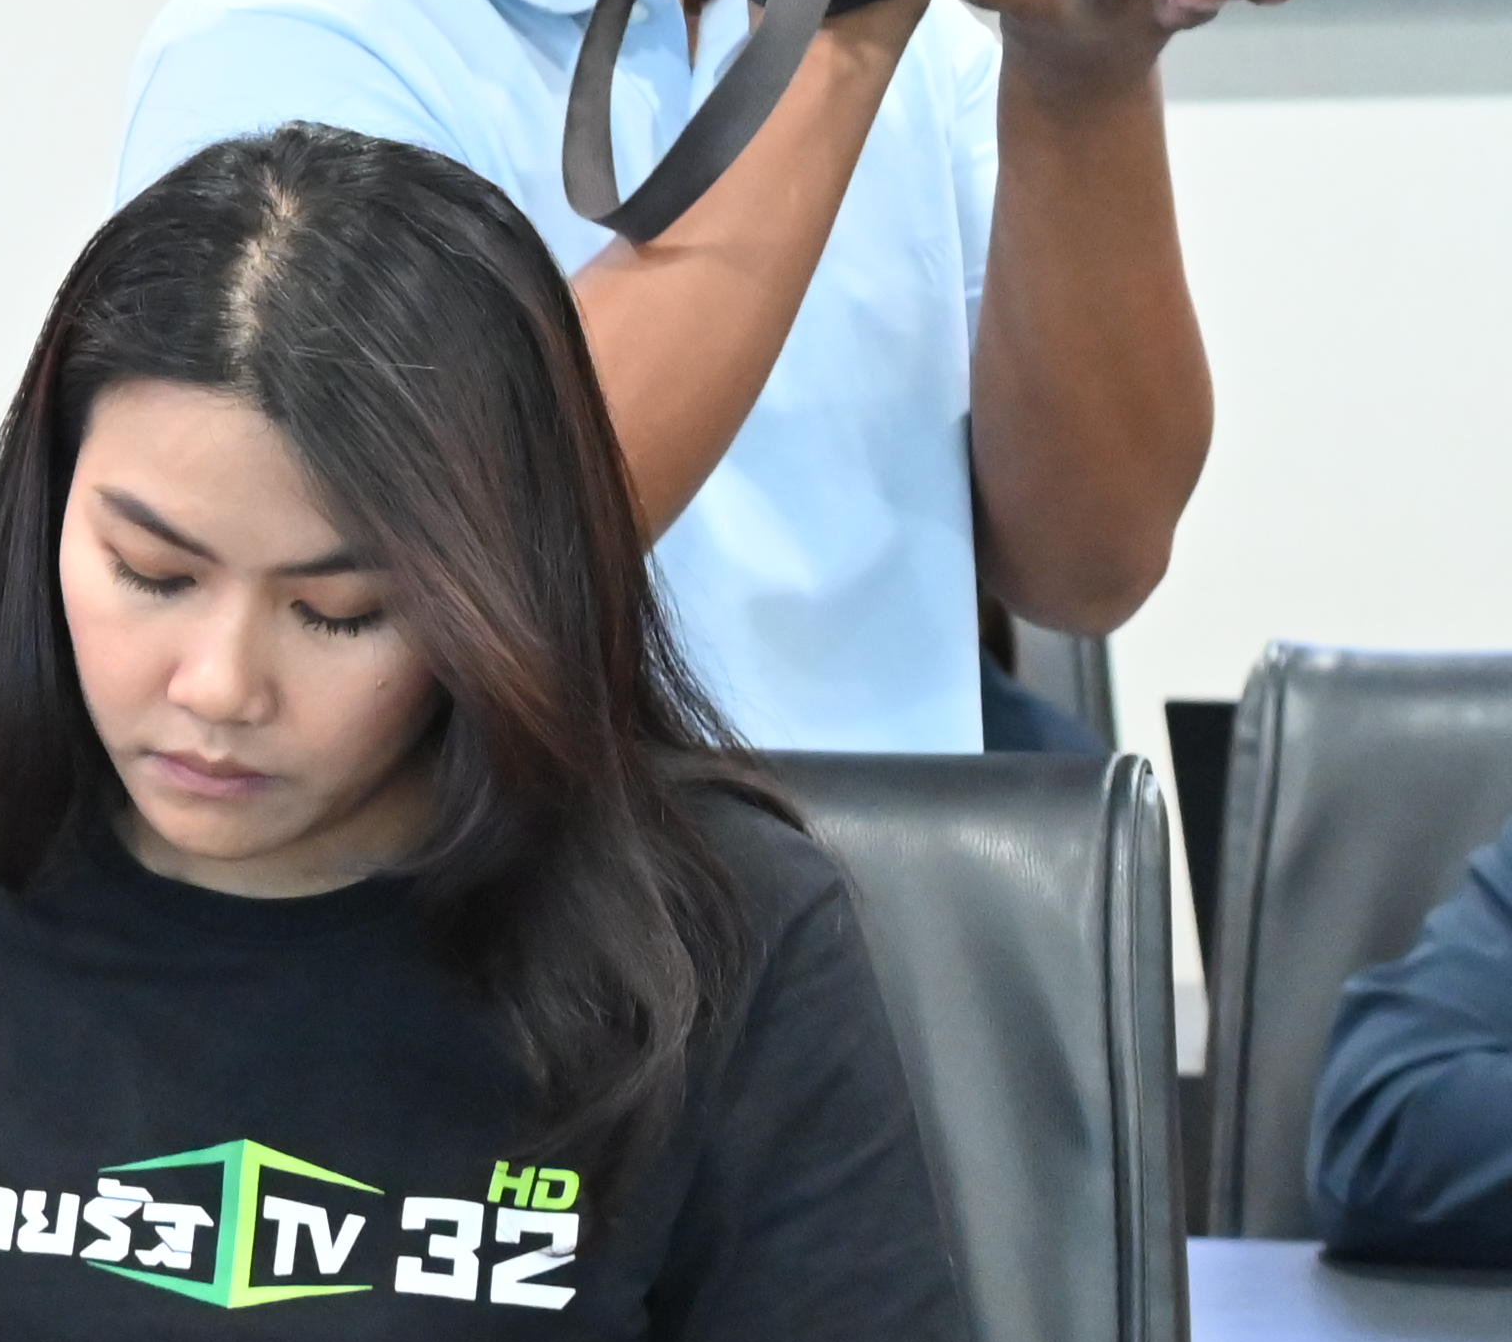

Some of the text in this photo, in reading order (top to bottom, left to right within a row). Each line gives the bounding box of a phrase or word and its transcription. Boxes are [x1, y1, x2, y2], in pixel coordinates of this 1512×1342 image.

[487, 1160, 580, 1210] HD
[263, 1195, 366, 1276] TV
[394, 1196, 580, 1310] 32
